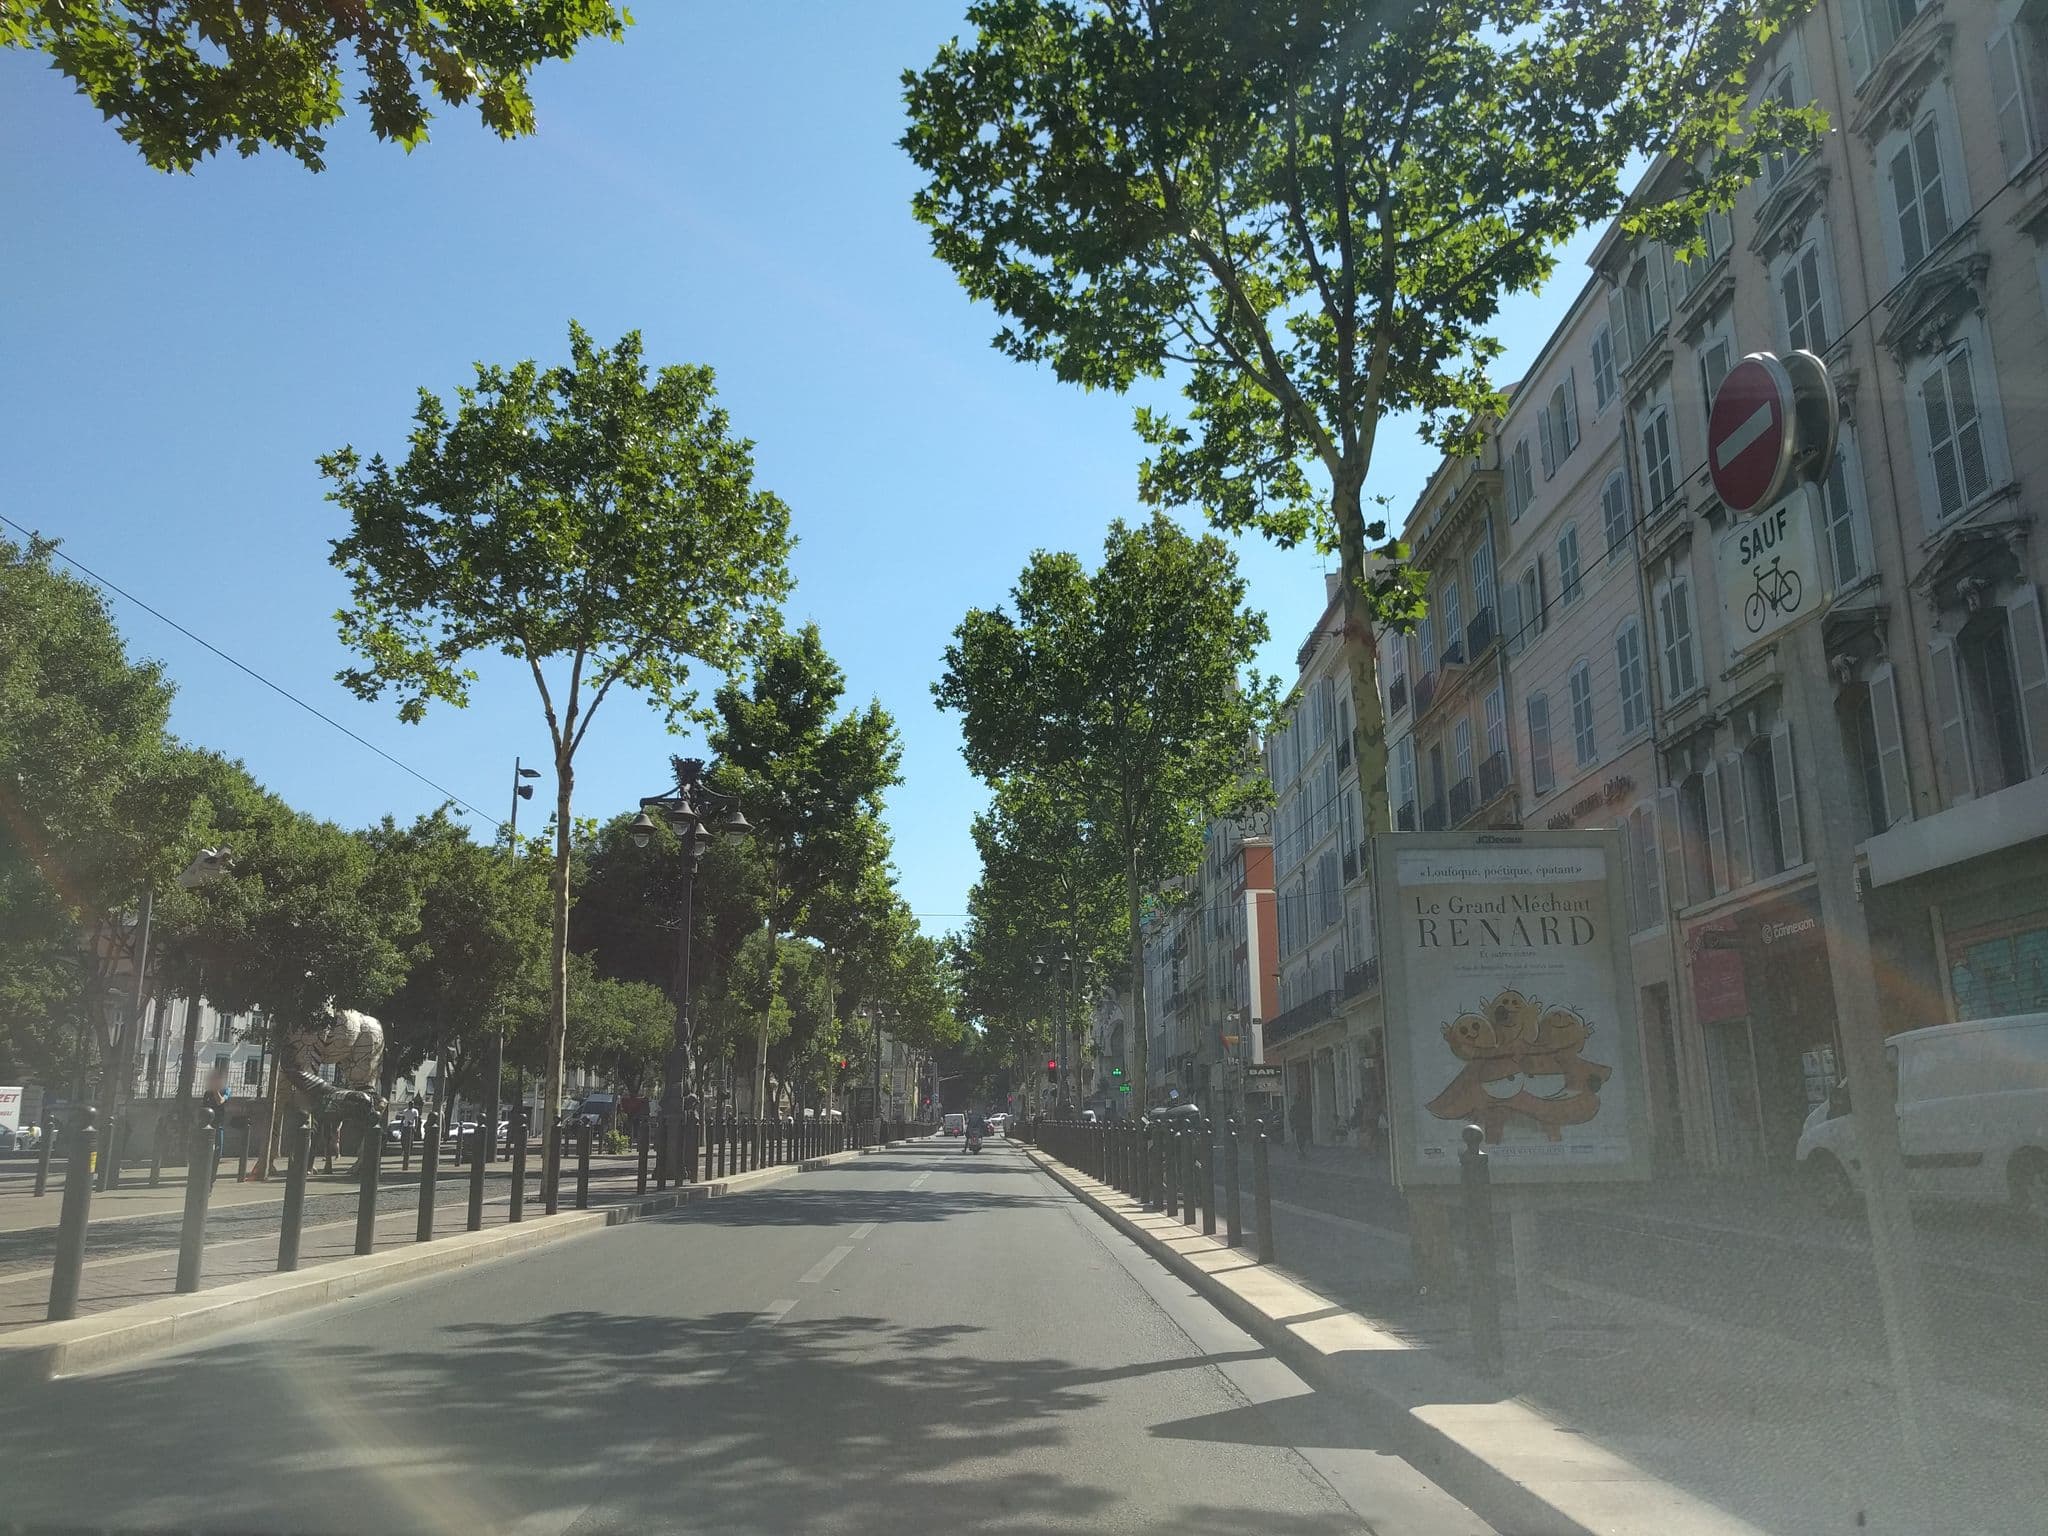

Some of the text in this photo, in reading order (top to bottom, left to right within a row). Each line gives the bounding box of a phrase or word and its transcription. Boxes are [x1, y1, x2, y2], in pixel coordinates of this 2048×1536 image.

[1739, 508, 1786, 566] SAUF
[1484, 864, 1533, 879] poétique,
[1536, 863, 1583, 878] épatant»
[1416, 892, 1592, 915] Le Grand Méchant
[1416, 915, 1596, 948] RENARD
